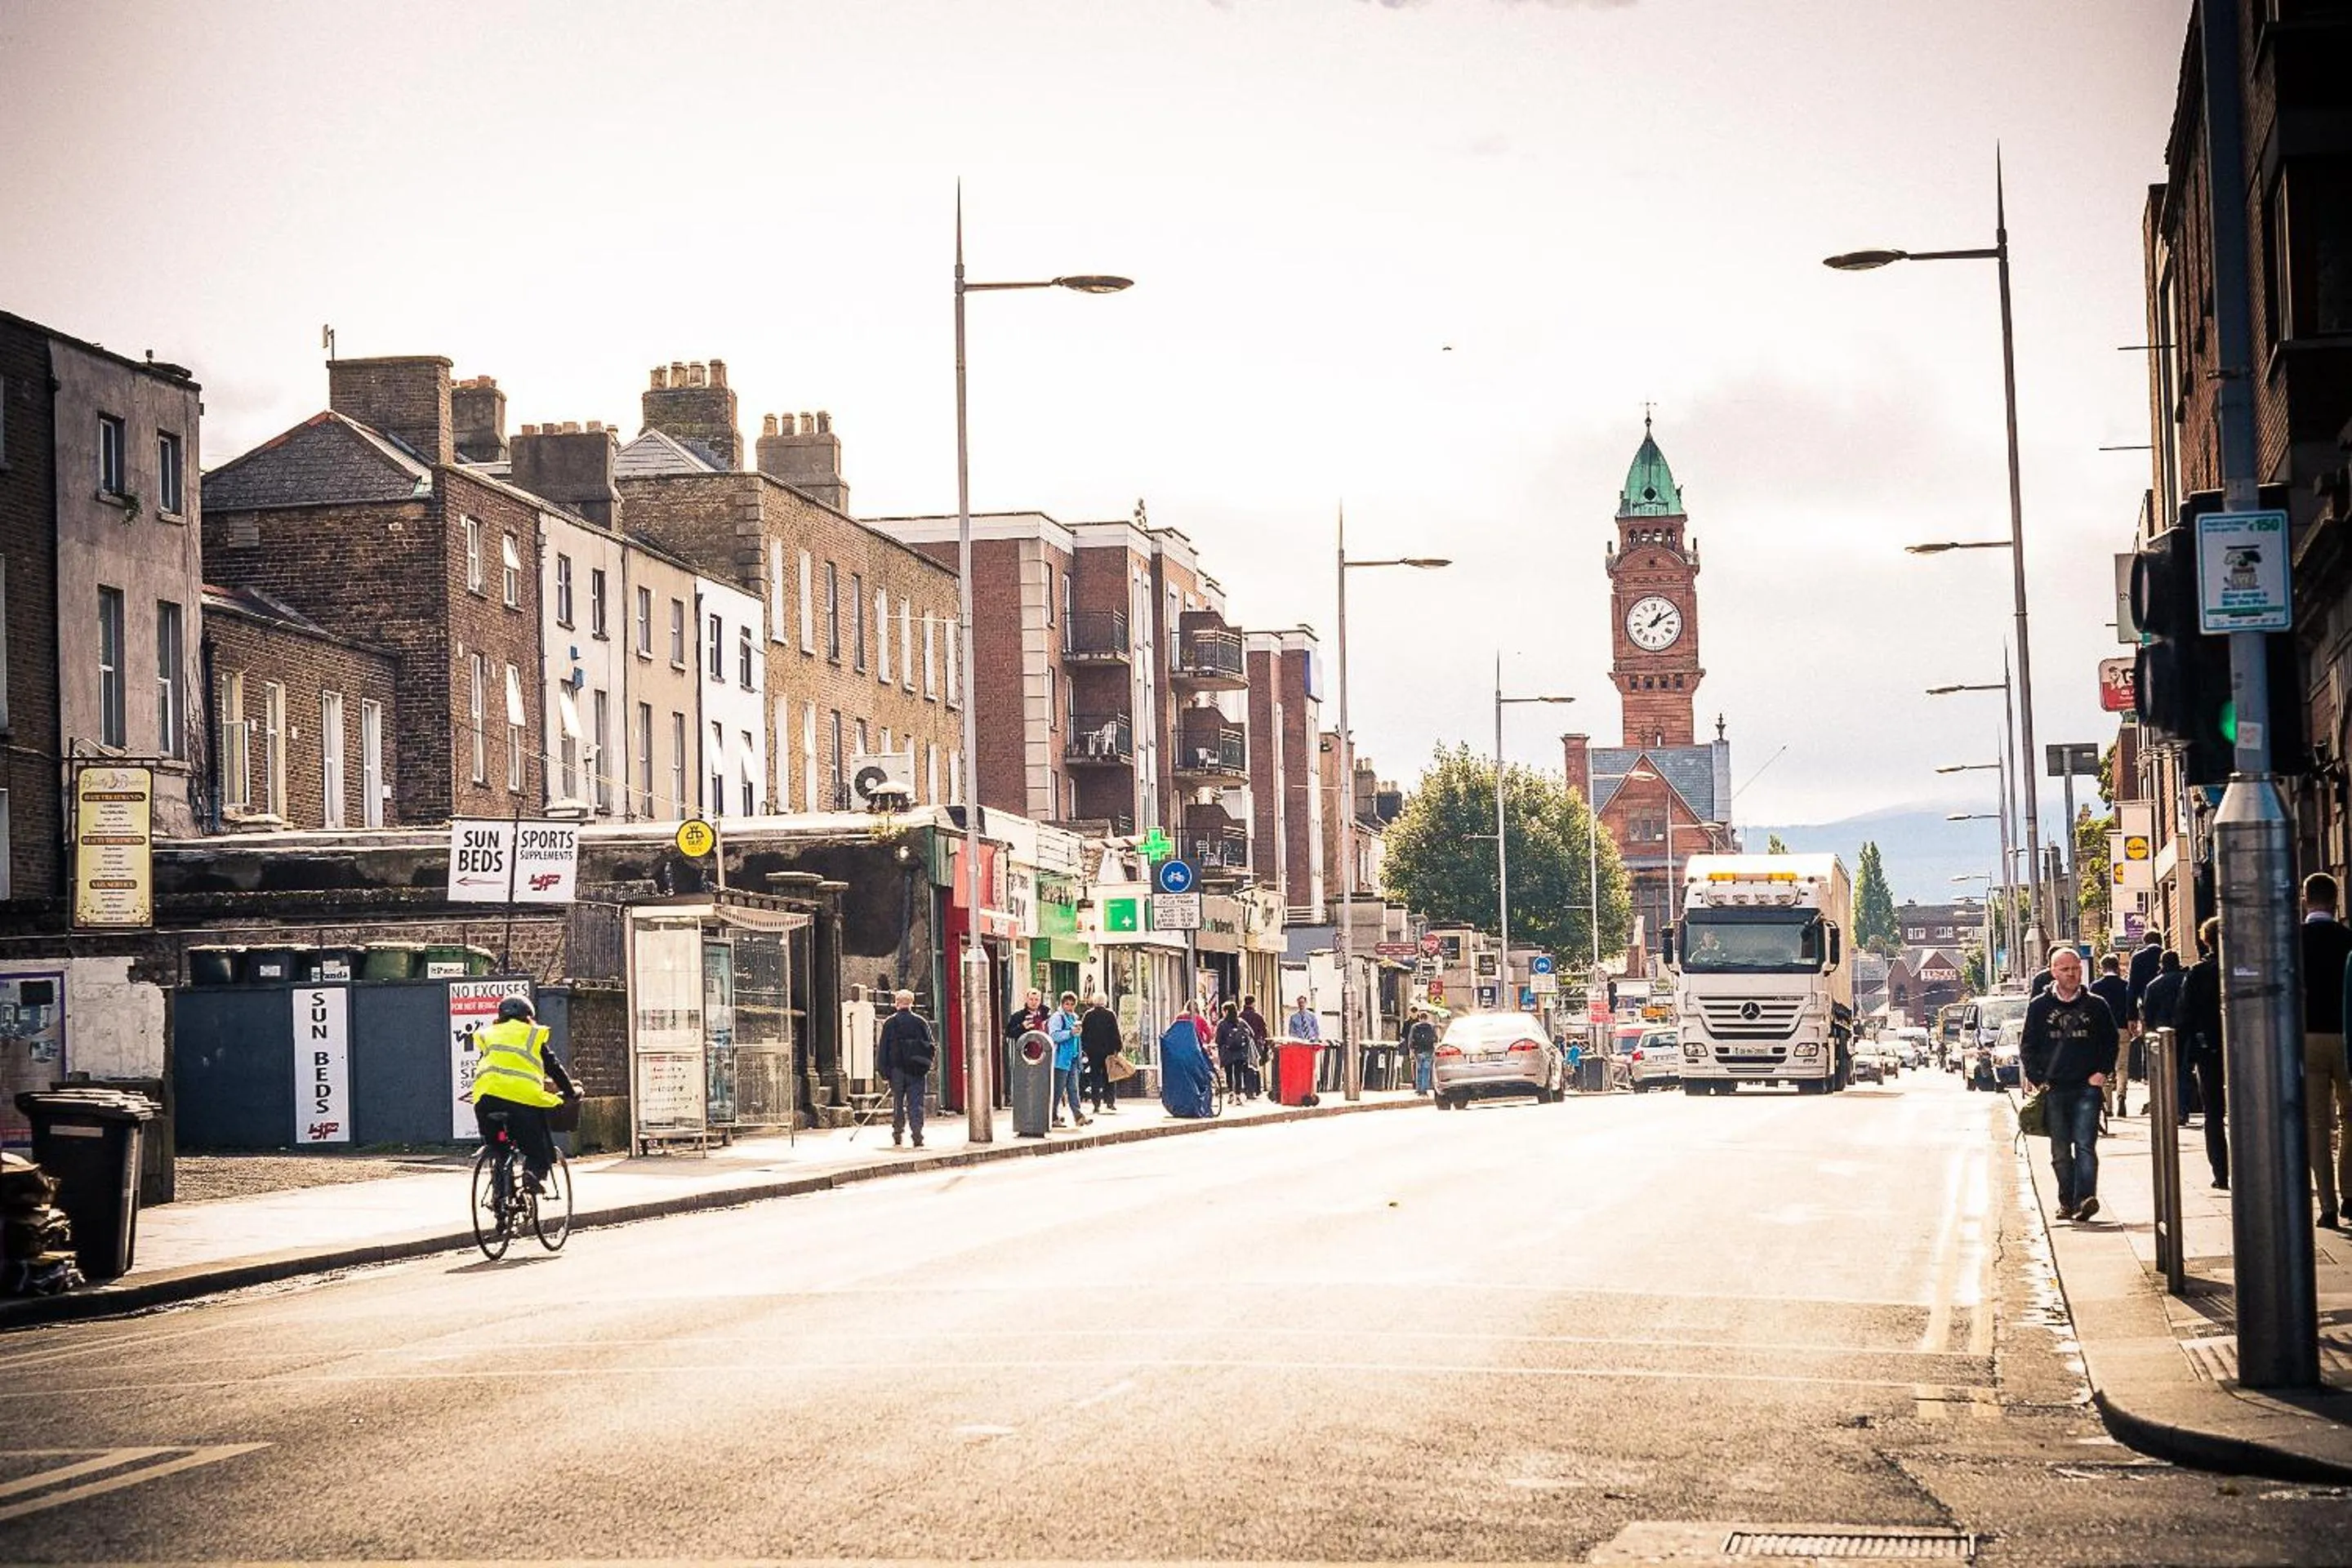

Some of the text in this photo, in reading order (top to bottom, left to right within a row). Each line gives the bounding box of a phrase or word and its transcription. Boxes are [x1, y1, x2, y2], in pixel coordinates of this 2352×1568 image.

[463, 831, 500, 848] SUN
[520, 830, 574, 849] SPORTS
[457, 849, 503, 872] BEDS
[519, 850, 572, 861] SUPPLEMENTS
[452, 984, 528, 997] NO EXCUSES
[312, 992, 327, 1040] SUN
[314, 1052, 332, 1114] BEDS
